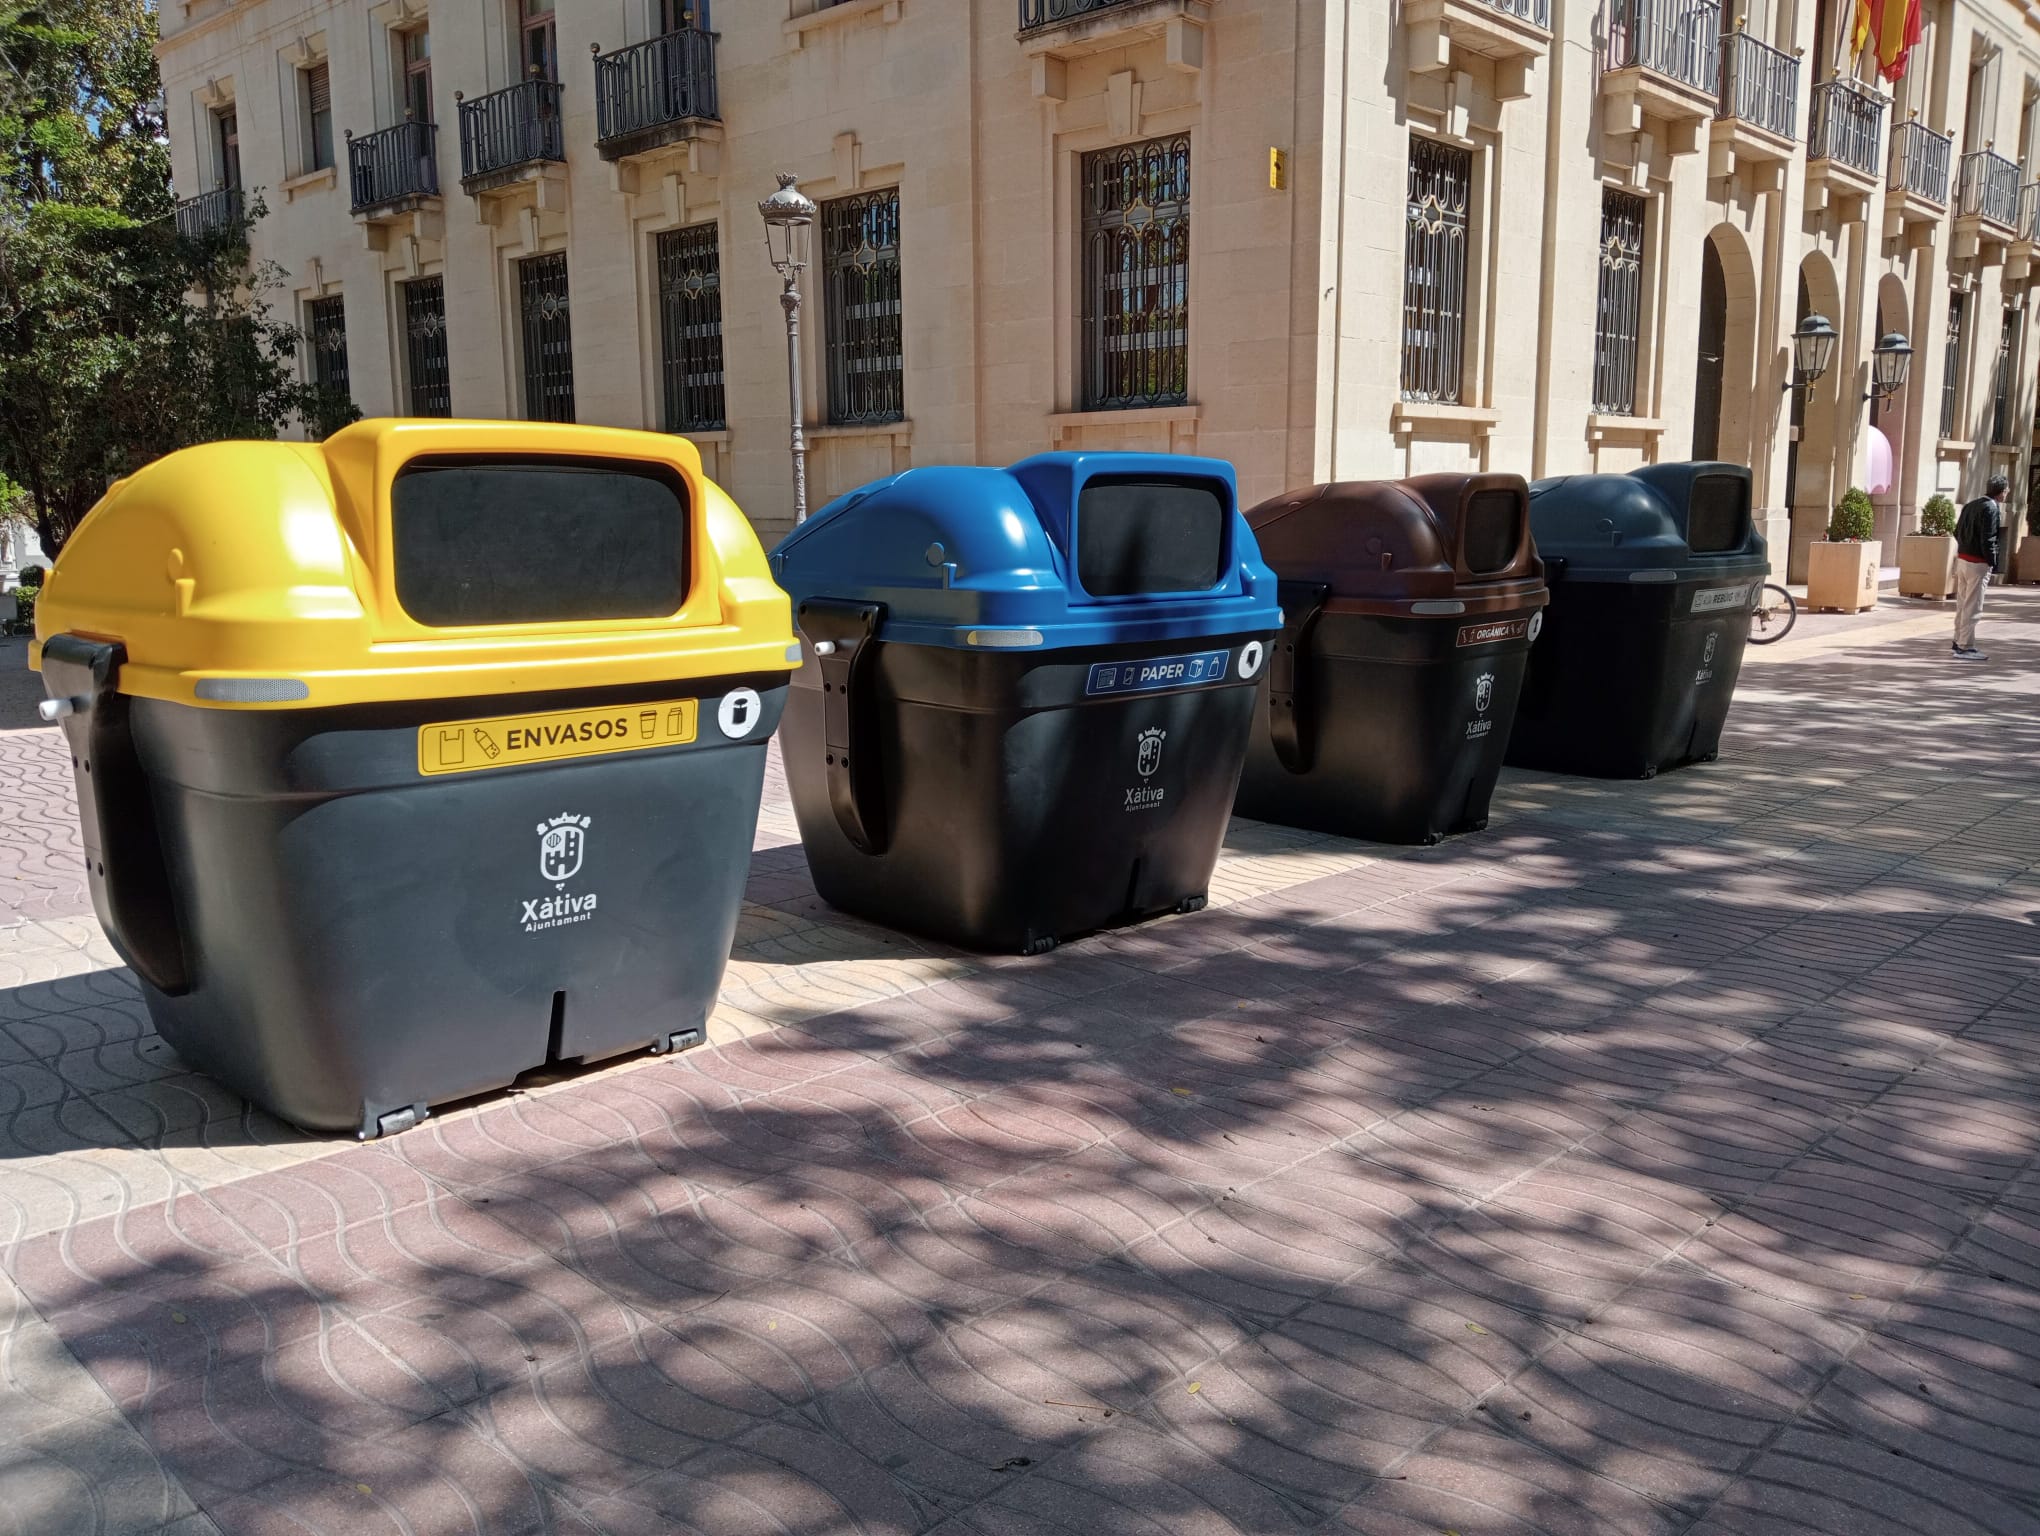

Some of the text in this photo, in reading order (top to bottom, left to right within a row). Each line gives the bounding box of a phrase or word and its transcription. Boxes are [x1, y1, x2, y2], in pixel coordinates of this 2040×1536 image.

[1140, 663, 1185, 682] PAPER
[507, 718, 628, 751] ENVASOS
[1124, 786, 1164, 805] Xàtiva
[1125, 801, 1160, 813] Ajuntament
[520, 893, 597, 924] Xàtiva
[525, 911, 592, 932] Ajuntament
